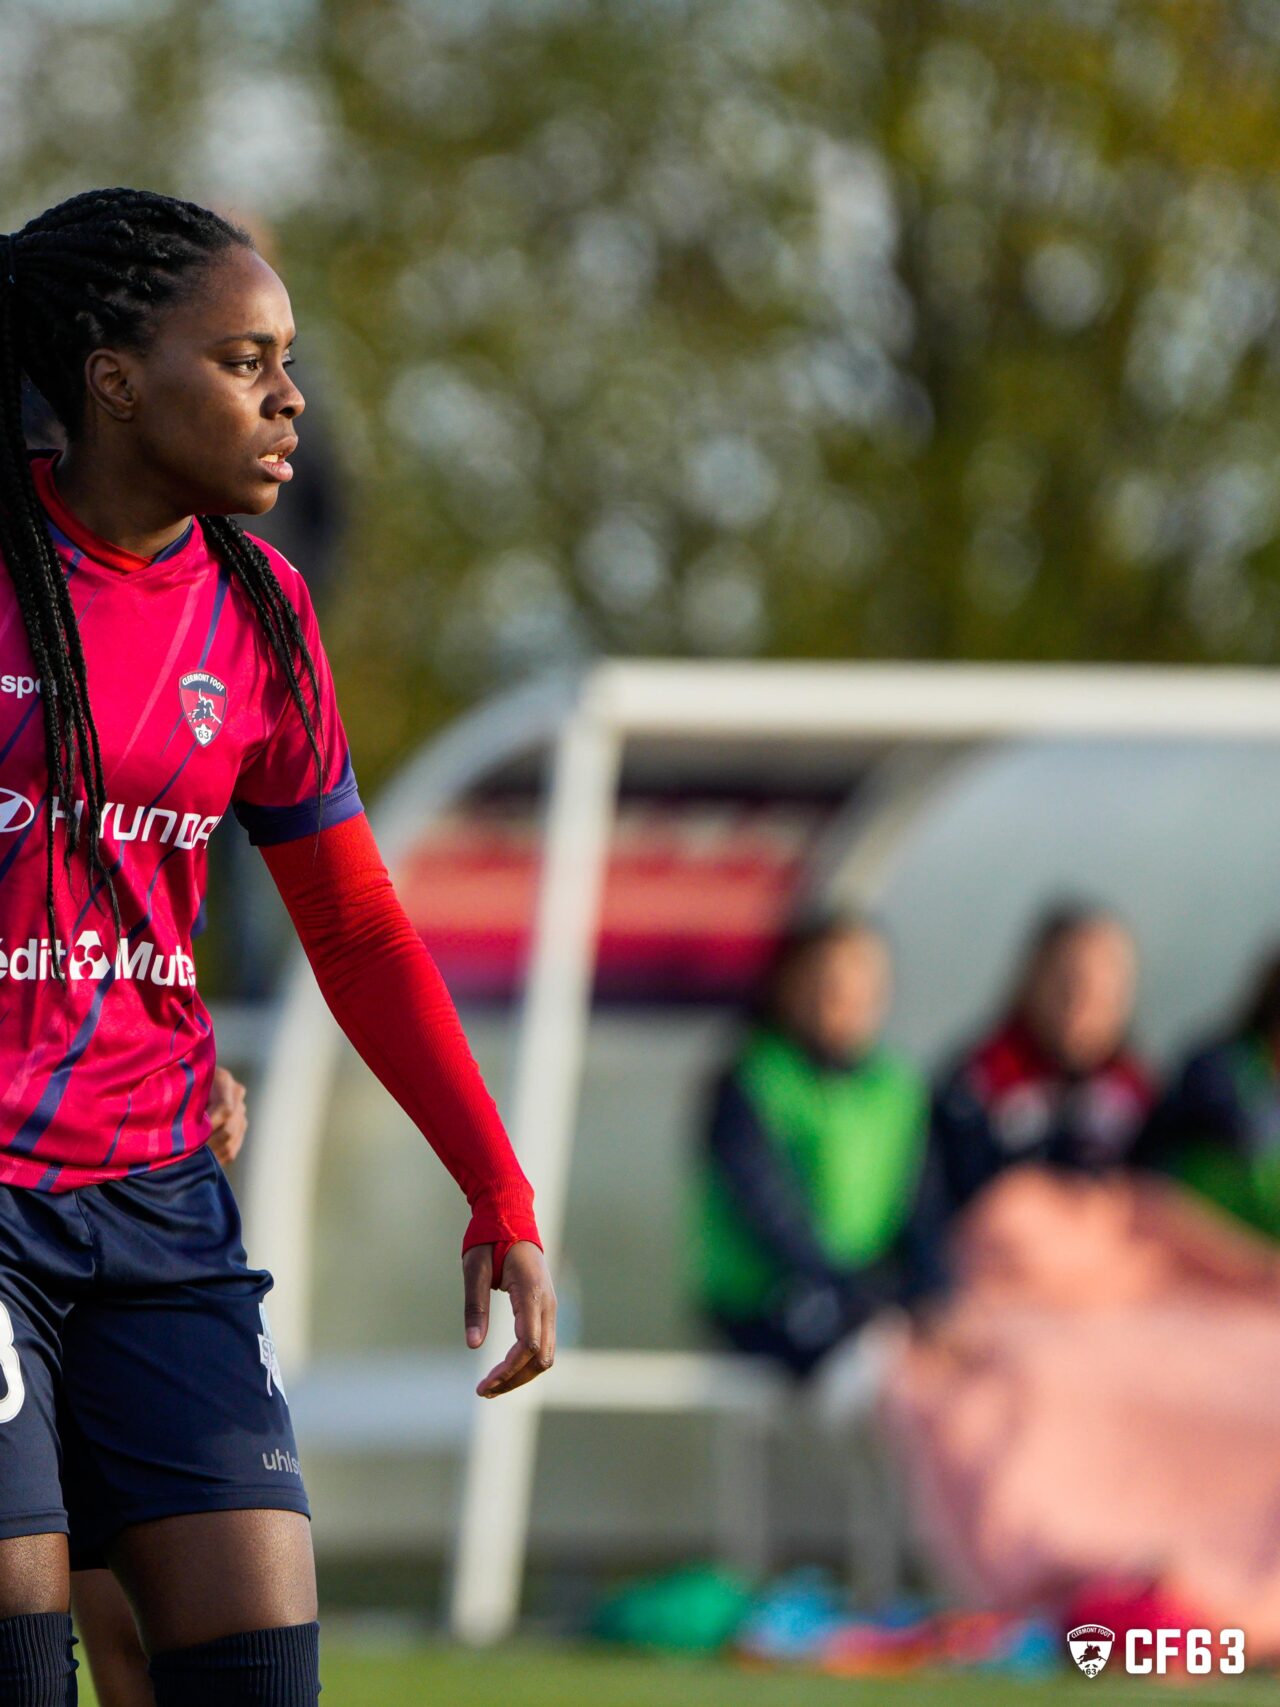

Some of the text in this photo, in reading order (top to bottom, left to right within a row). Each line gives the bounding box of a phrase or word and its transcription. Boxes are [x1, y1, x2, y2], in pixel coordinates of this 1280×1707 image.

[182, 673, 224, 692] CLERMONT FOOT
[198, 729, 210, 739] 63
[52, 796, 222, 850] HYUNDA
[262, 1448, 302, 1482] uhls
